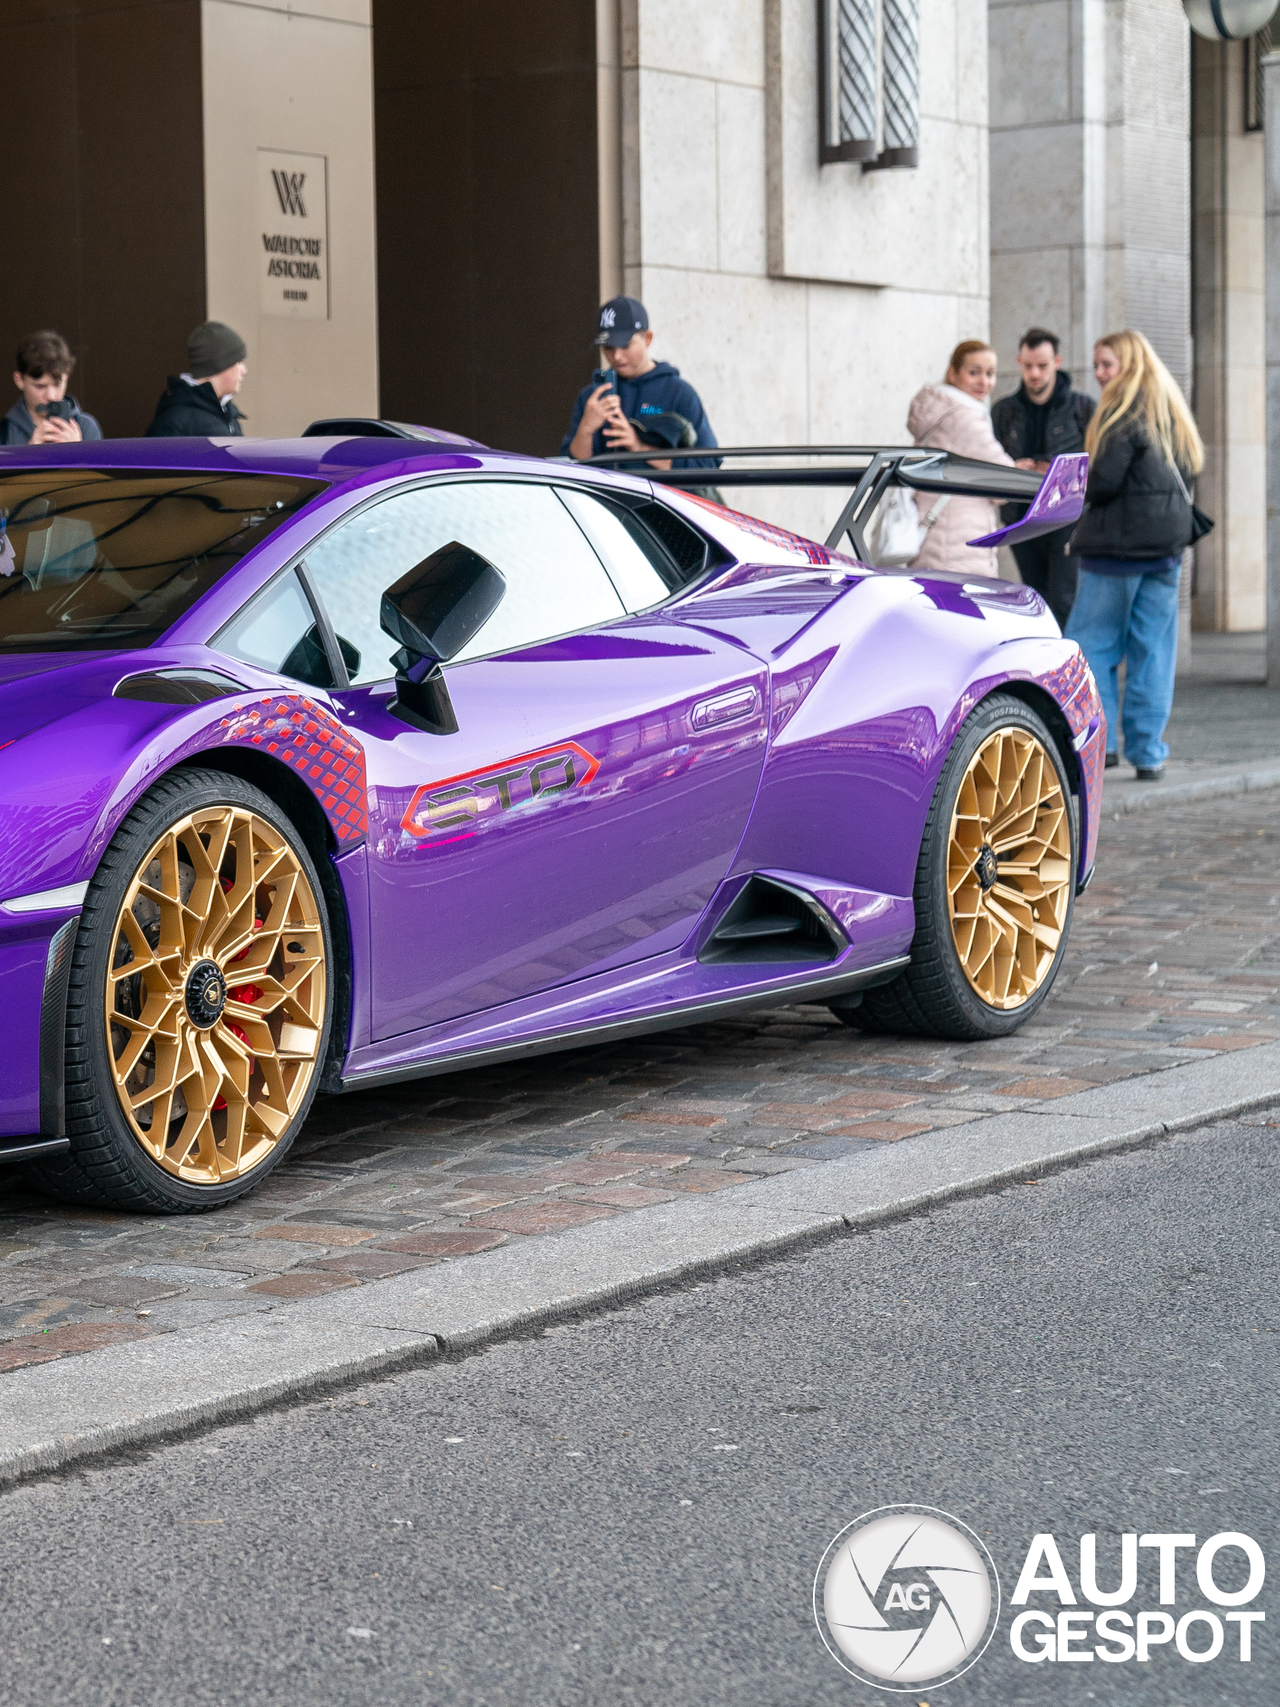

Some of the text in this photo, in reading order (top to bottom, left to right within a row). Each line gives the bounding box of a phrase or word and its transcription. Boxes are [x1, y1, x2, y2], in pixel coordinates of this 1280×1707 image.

[262, 232, 322, 257] WALDORF
[268, 257, 321, 281] ASTORIA
[426, 754, 577, 830] STO
